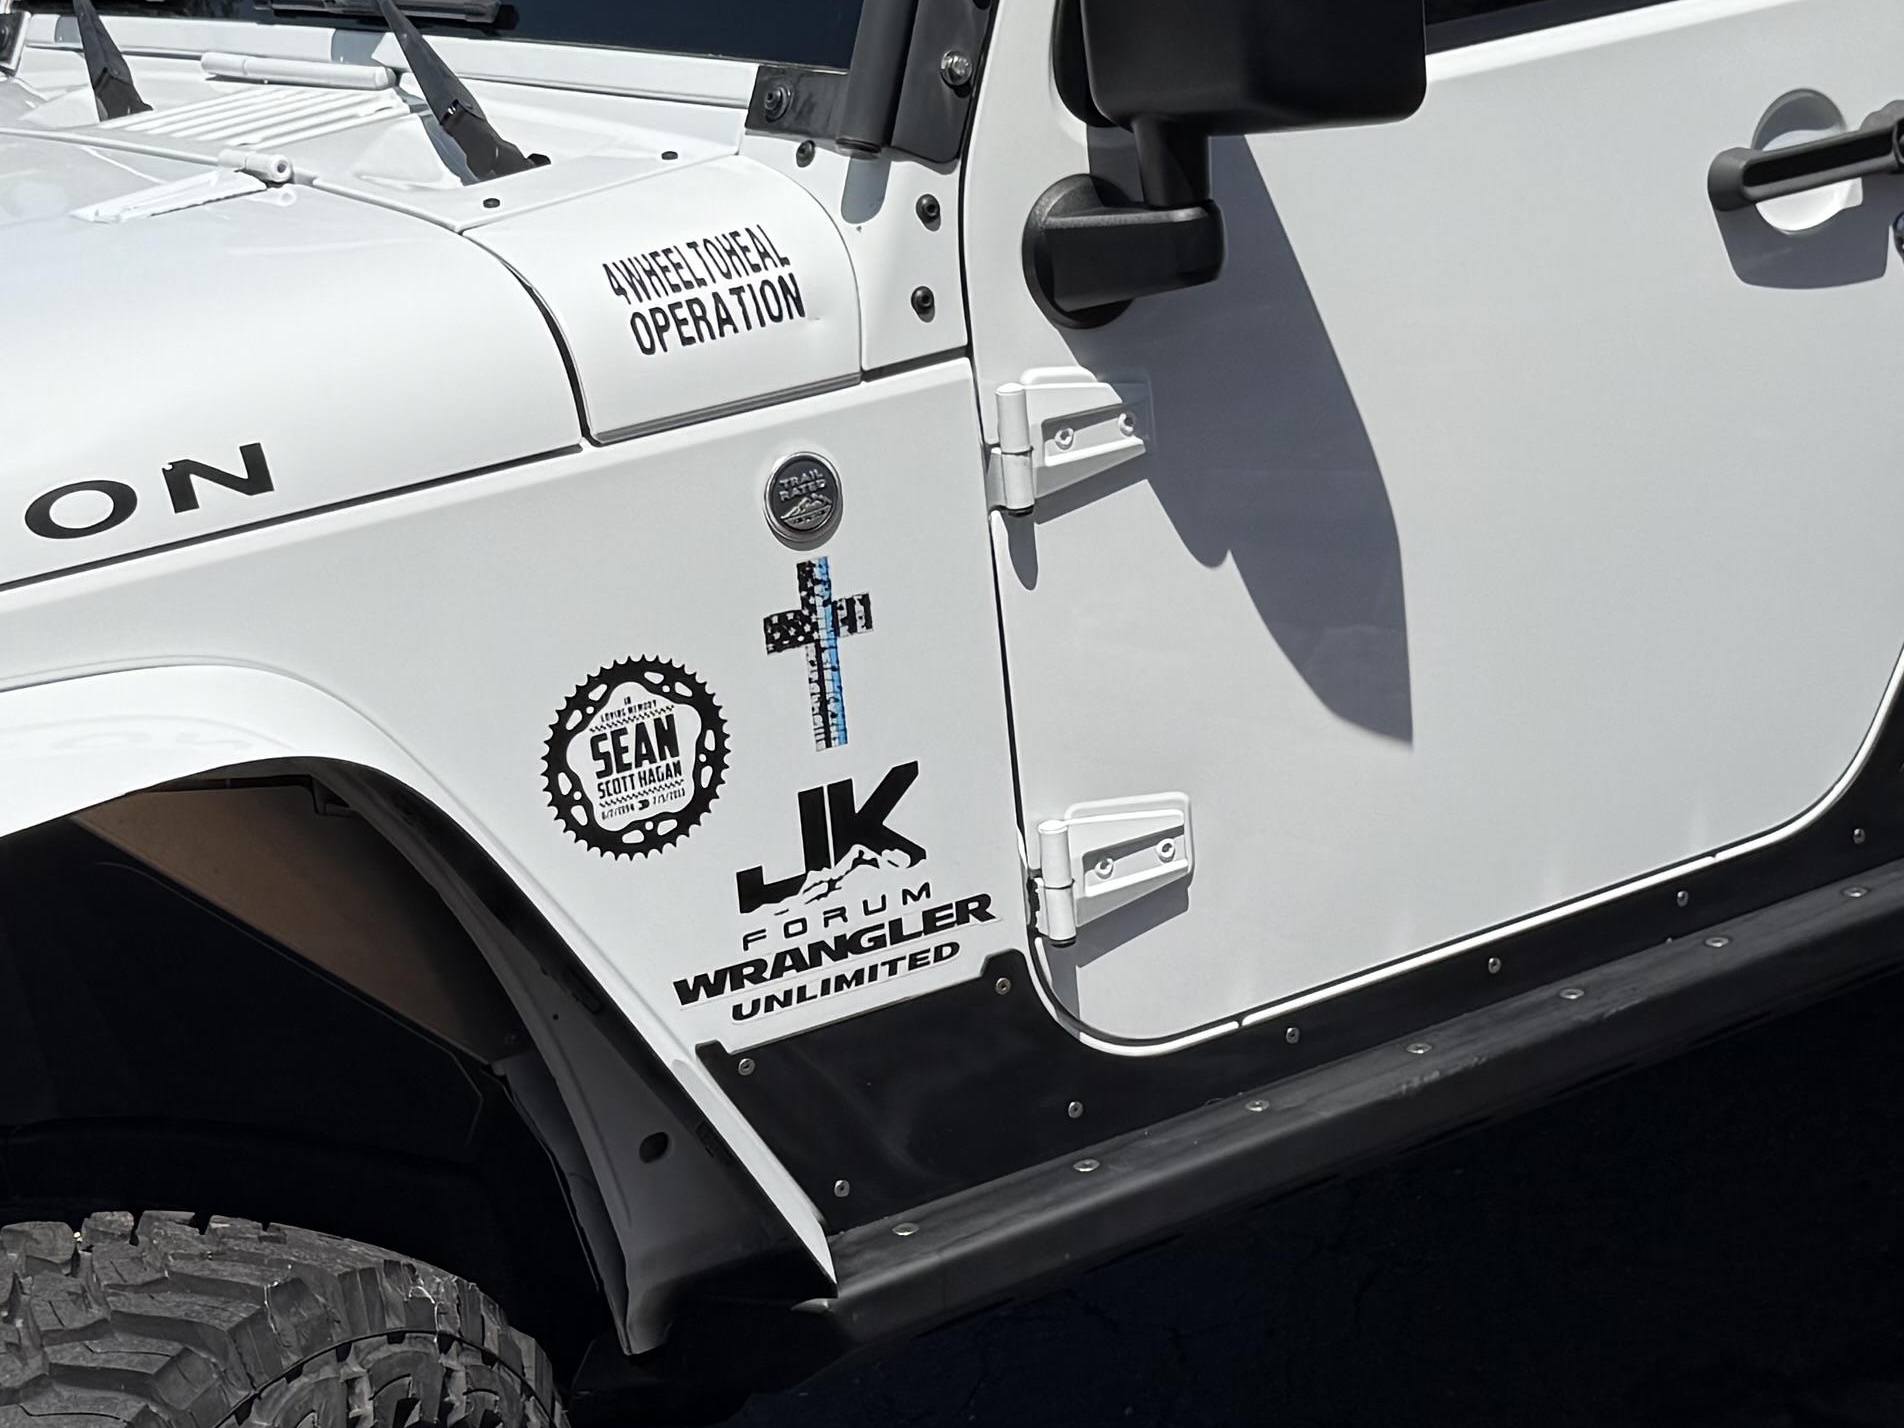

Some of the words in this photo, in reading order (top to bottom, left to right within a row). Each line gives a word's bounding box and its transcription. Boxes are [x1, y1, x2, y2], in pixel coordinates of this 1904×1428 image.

[629, 271, 807, 357] OPERATION
[778, 467, 824, 489] TRAIL
[778, 478, 827, 502] RATED
[589, 713, 681, 780] SEAN
[597, 773, 636, 800] SCOTT
[637, 759, 683, 788] HAGAN
[735, 760, 928, 914] JK
[672, 893, 997, 1006] WRANGLER
[741, 881, 933, 952] FORUM
[730, 940, 962, 1023] UNLIMITED
